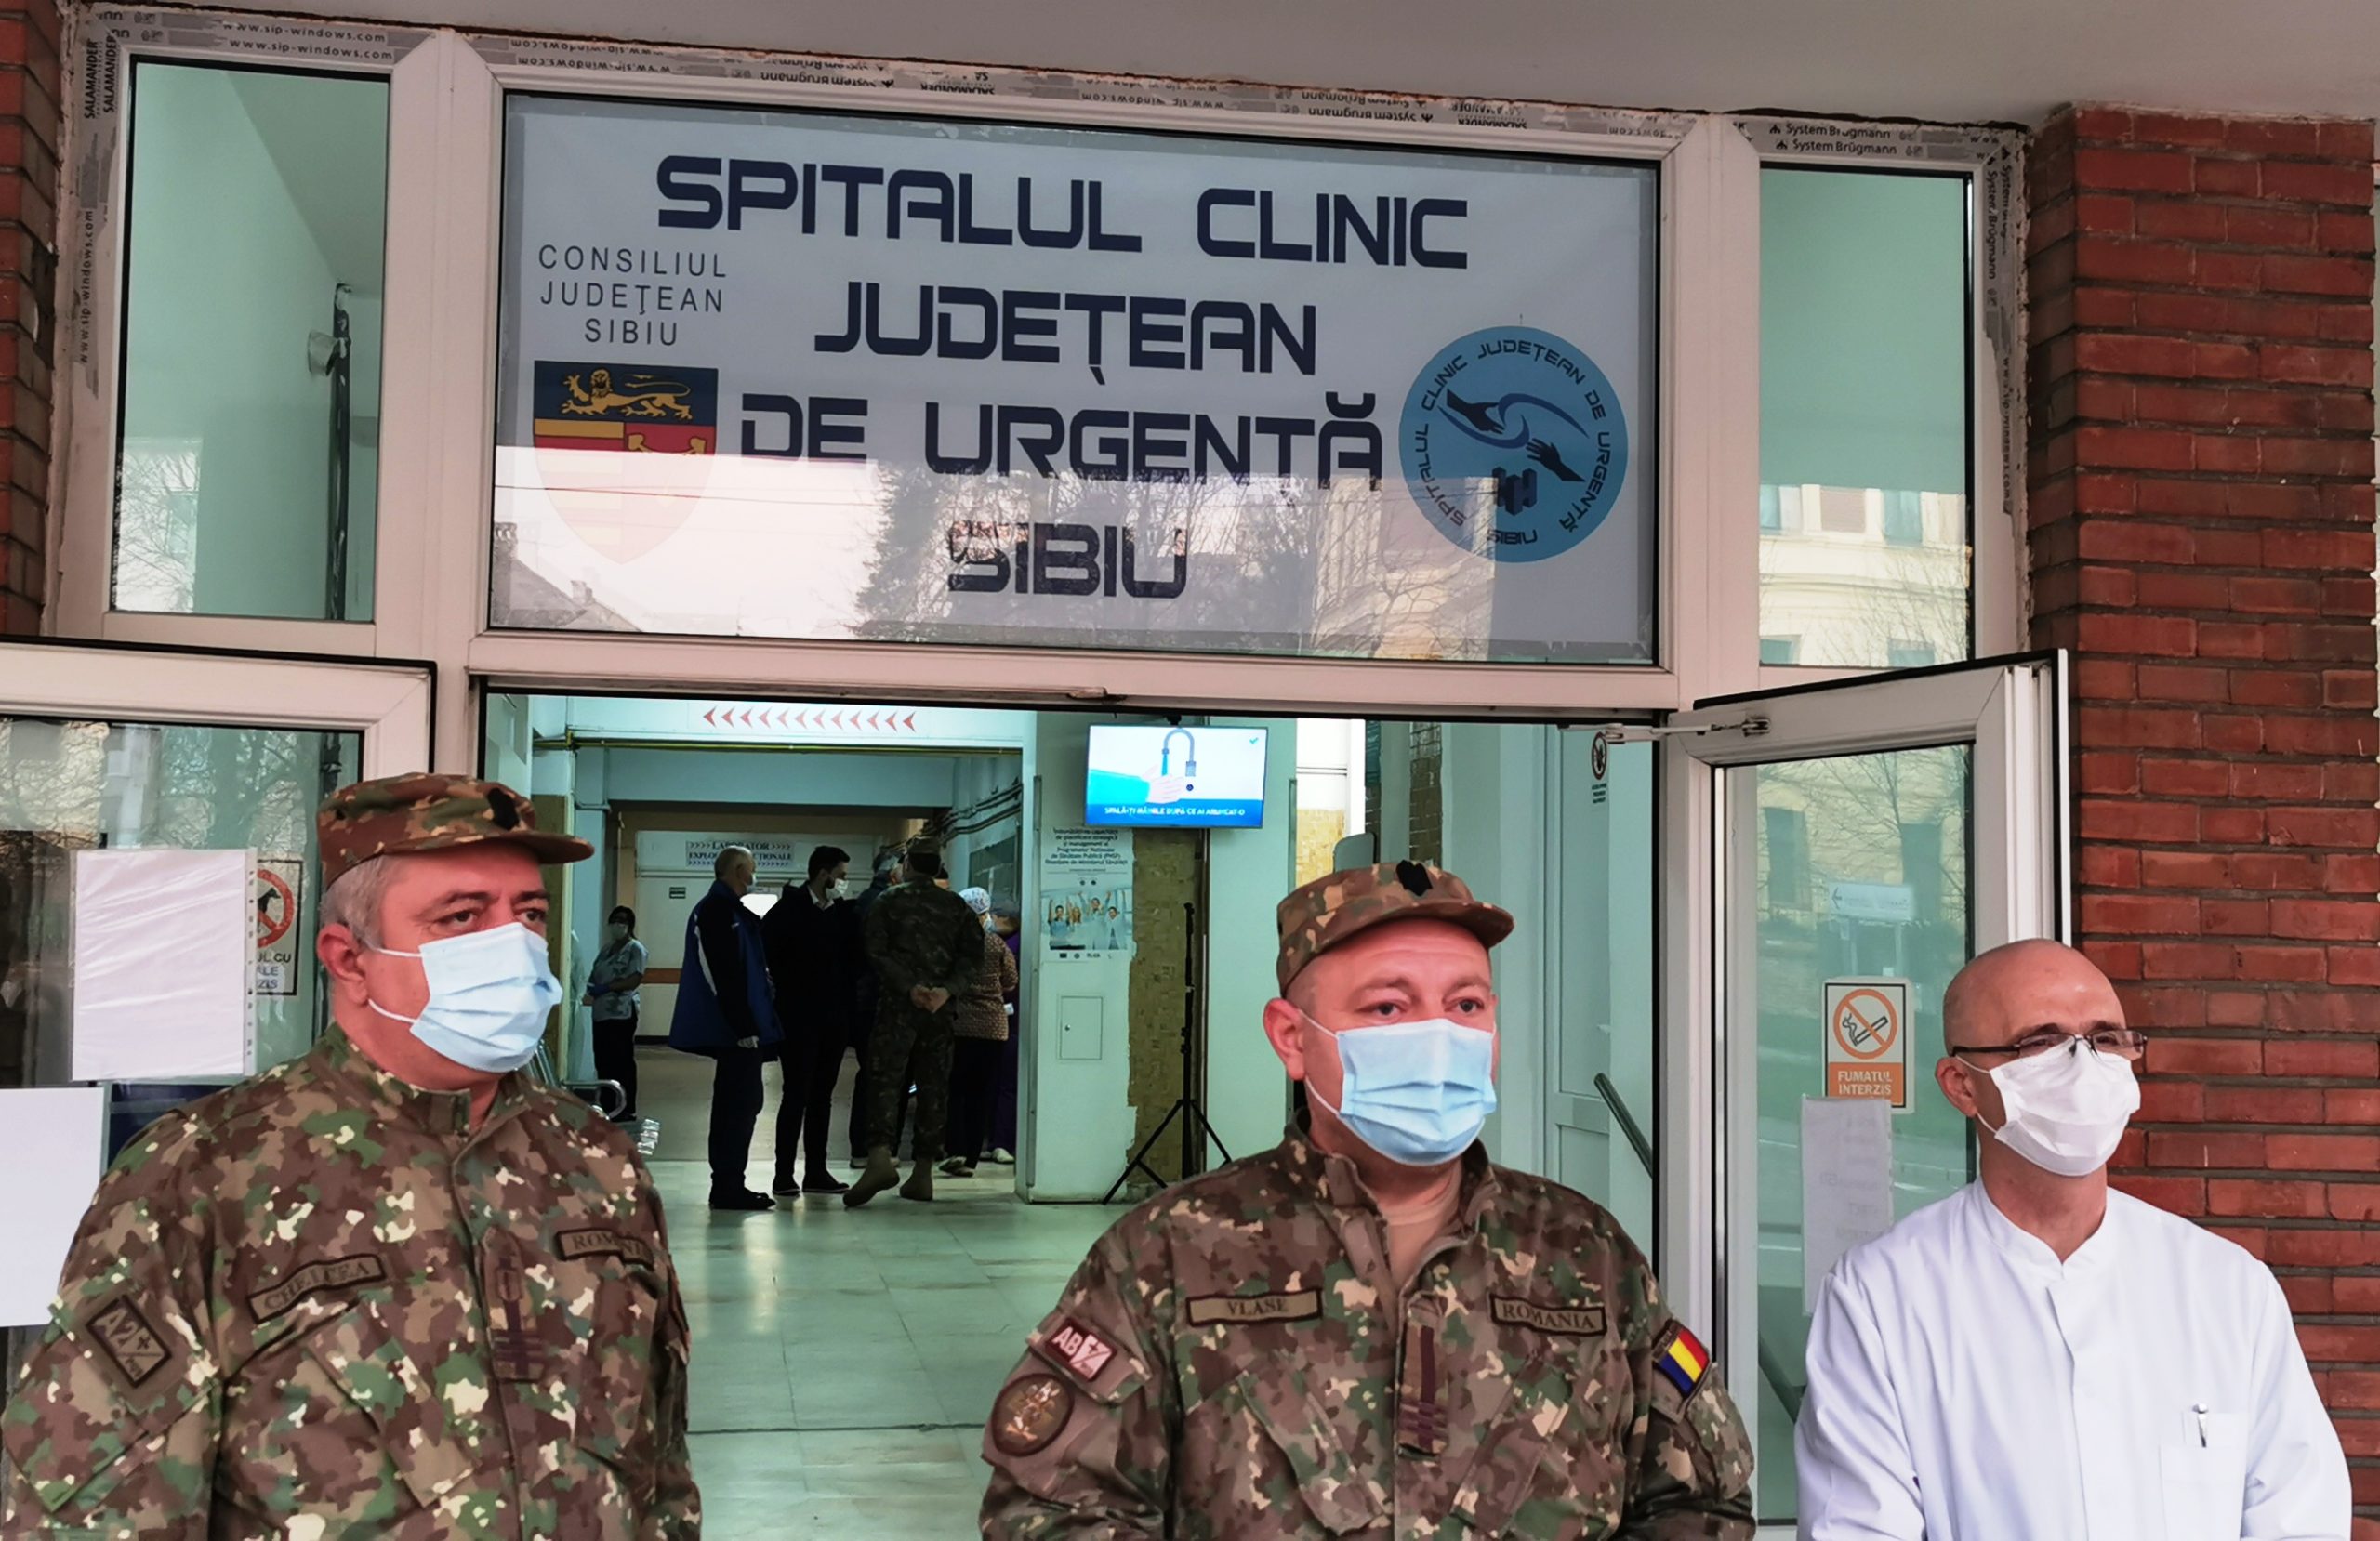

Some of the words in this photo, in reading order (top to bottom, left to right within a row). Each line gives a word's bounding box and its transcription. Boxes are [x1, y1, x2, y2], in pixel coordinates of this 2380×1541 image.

[230, 38, 393, 60] www.sip-windows.com
[84, 38, 99, 119] SALAMANDER
[1786, 124, 1828, 138] System
[1792, 139, 1835, 153] System
[656, 155, 1143, 253] SPITALUL
[1197, 188, 1468, 270] CLINIC
[538, 244, 727, 278] CONSILIUL
[585, 318, 677, 346] SIBIU
[1421, 354, 1468, 411] CLINIC
[1584, 389, 1607, 420] DE
[740, 393, 868, 461] DE
[1415, 423, 1467, 527] SPITALUL
[1485, 528, 1538, 545] SIBIU
[947, 520, 1187, 599] SIBIU
[273, 953, 291, 963] CU
[1838, 1070, 1893, 1082] FUMATUL
[1839, 1083, 1892, 1095] INTERZIS
[1503, 1302, 1596, 1329] ROMANIA
